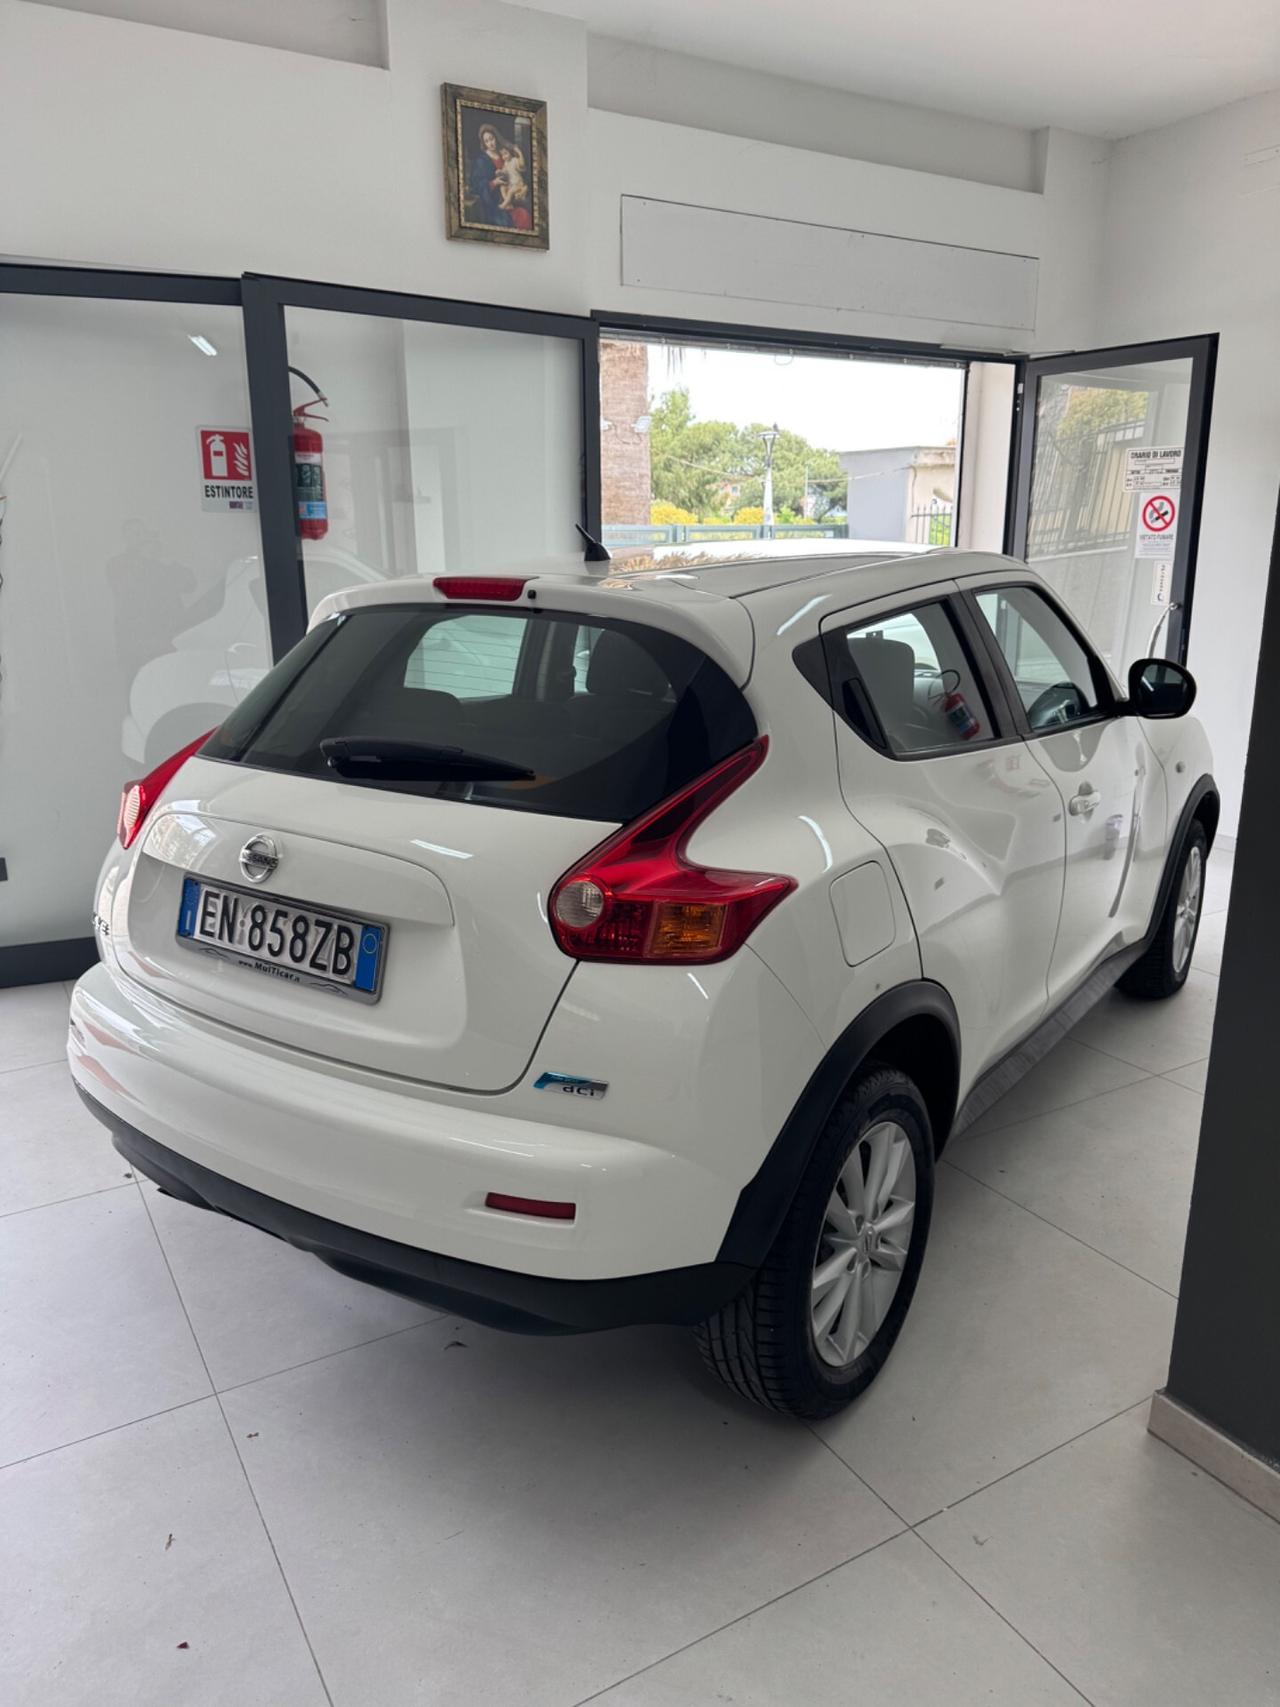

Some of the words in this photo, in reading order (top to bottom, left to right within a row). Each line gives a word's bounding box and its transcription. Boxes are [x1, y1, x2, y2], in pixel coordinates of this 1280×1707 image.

[1152, 450, 1159, 458] DI
[204, 485, 254, 499] ESTINTORE
[199, 889, 240, 944] EN
[248, 904, 355, 976] 858ZB
[562, 1085, 594, 1096] dCi
